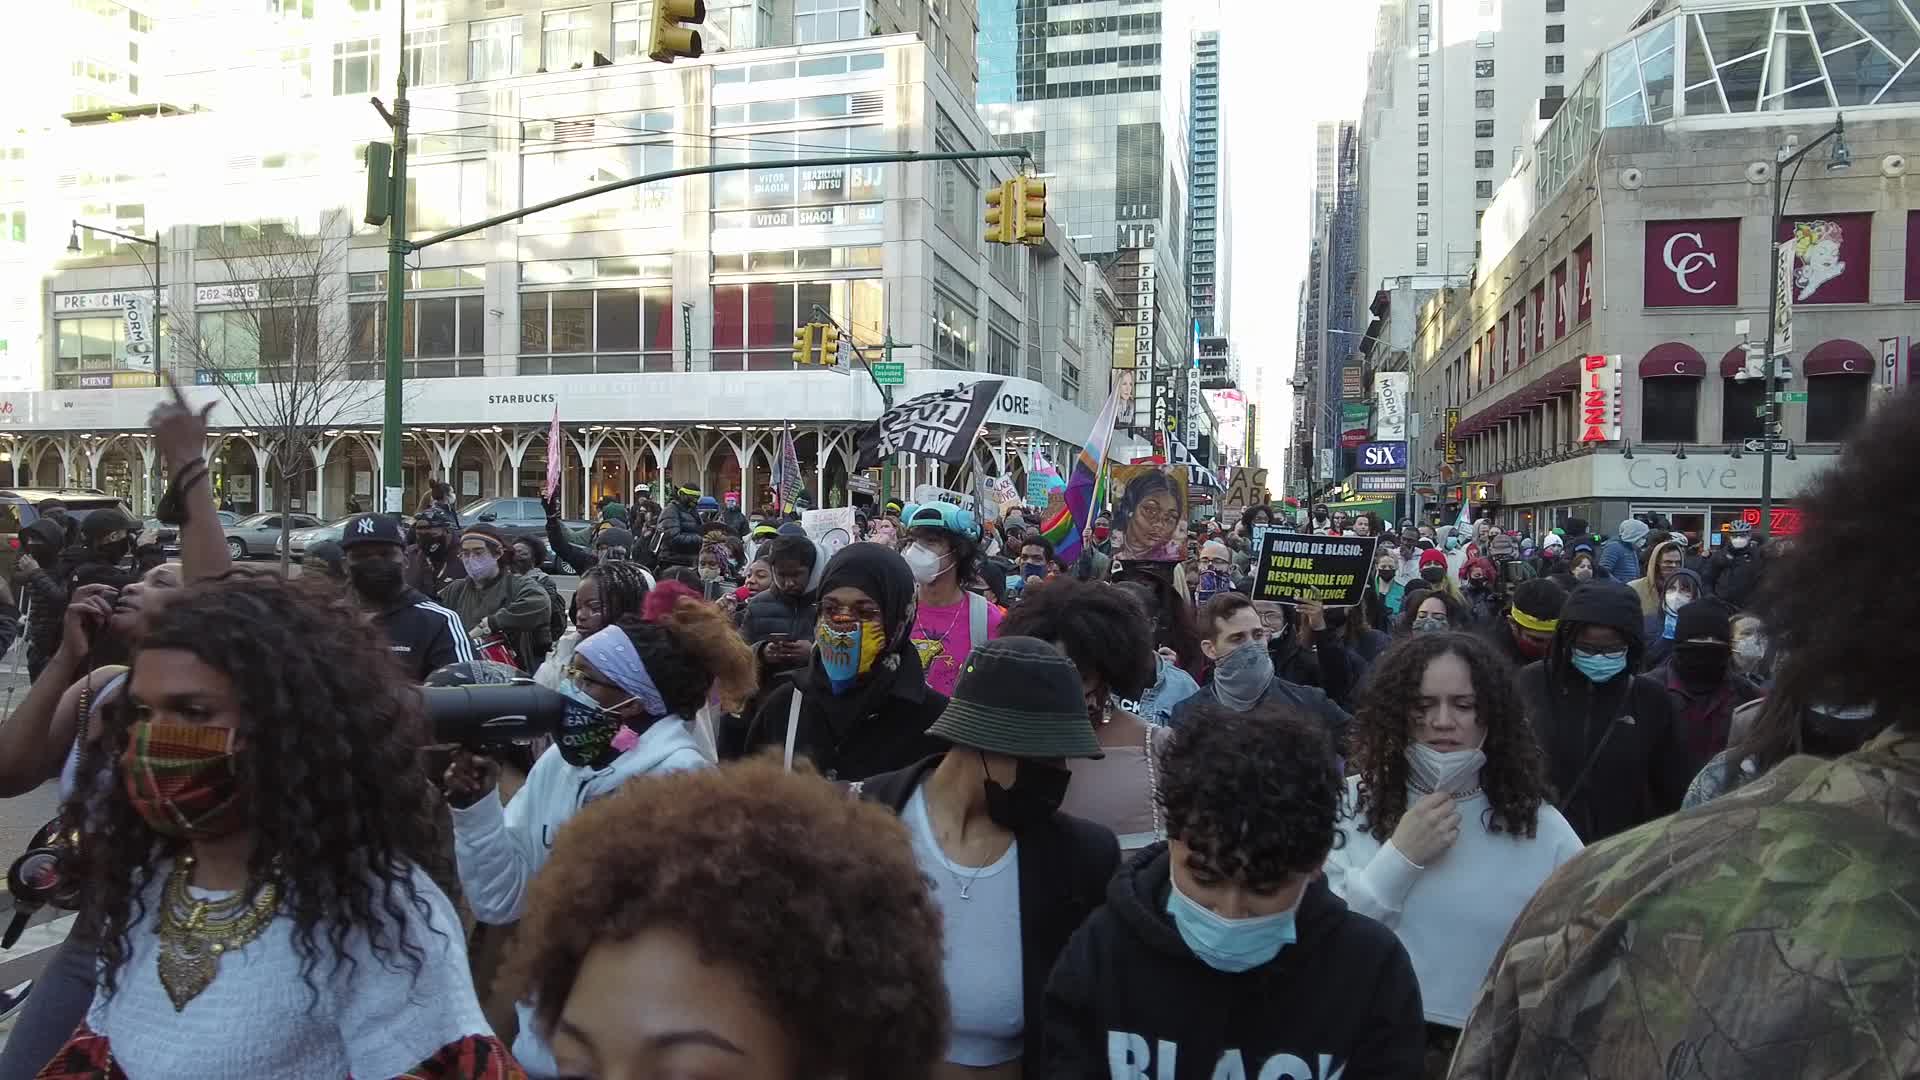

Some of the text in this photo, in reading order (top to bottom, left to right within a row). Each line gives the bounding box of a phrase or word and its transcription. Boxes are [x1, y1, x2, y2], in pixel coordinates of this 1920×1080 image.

[760, 173, 785, 183] VITOR
[818, 179, 841, 190] JITSU
[851, 167, 882, 187] BJJ
[757, 213, 787, 226] VITOR
[1117, 224, 1155, 248] MTC
[1139, 266, 1150, 381] FRIEDMAN
[82, 377, 110, 385] SCIENCE
[489, 394, 555, 404] STARBUCKS
[996, 393, 1029, 415] ORE
[1380, 379, 1402, 435] MORMON
[1584, 354, 1607, 441] PIZZA
[1154, 385, 1167, 431] PARK
[1189, 371, 1198, 447] BARRYMORE
[1628, 459, 1737, 492] Carve
[1743, 509, 1806, 535] PZZ
[1272, 539, 1309, 554] MAYOR
[1311, 543, 1324, 555] DE
[1324, 543, 1363, 557] BLASIO:
[1270, 555, 1313, 570] YOU ARE
[1267, 570, 1355, 586] RESPONSIBLE FOR
[1302, 588, 1347, 600] VILENCE
